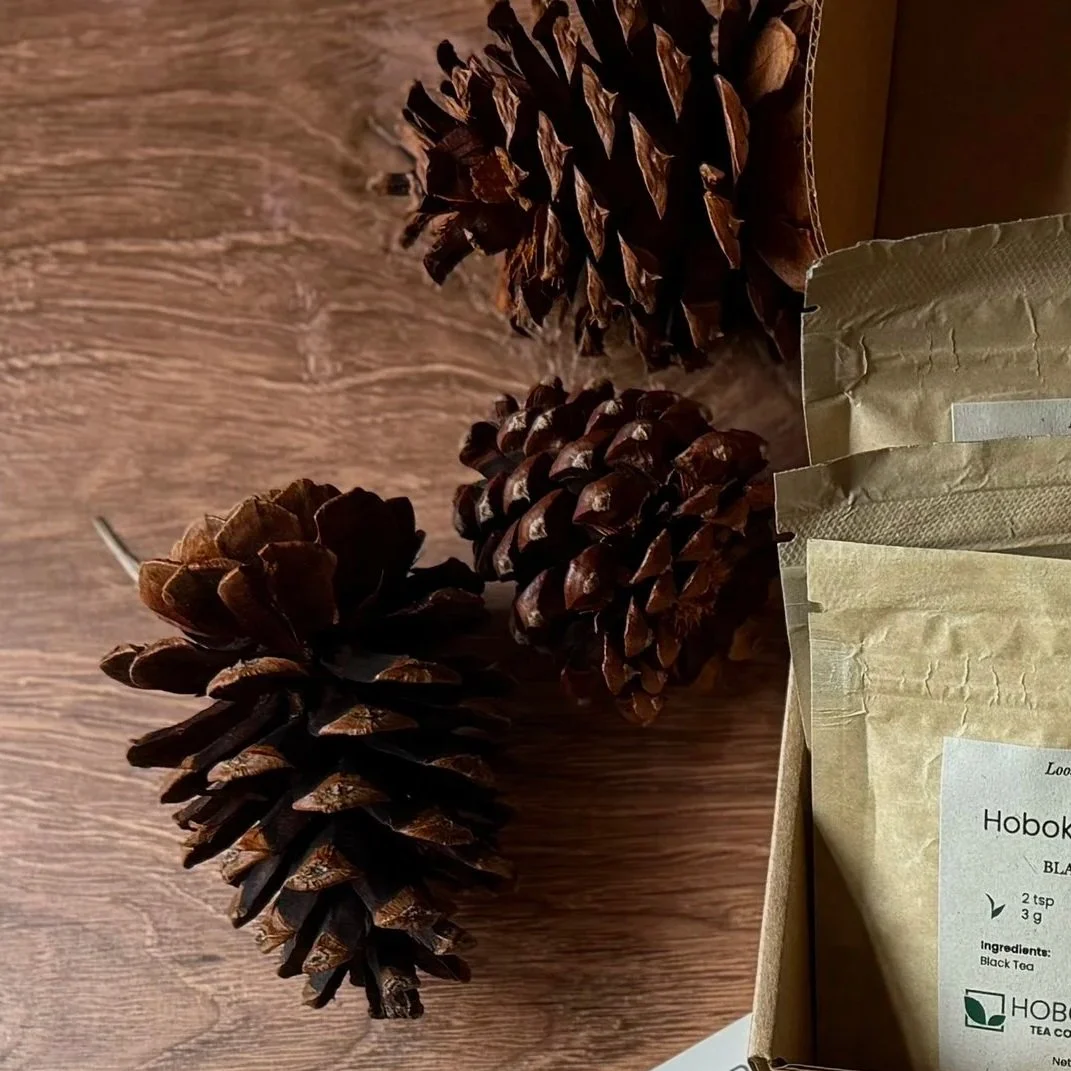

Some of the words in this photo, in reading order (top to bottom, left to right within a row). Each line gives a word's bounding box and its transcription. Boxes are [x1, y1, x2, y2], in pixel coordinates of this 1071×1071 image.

[1033, 894, 1055, 909] tsp
[980, 940, 1051, 958] Ingredients:
[980, 955, 1011, 969] Black
[1012, 959, 1035, 972] Tea
[1029, 1024, 1052, 1037] TEA
[1052, 1056, 1071, 1068] Net
